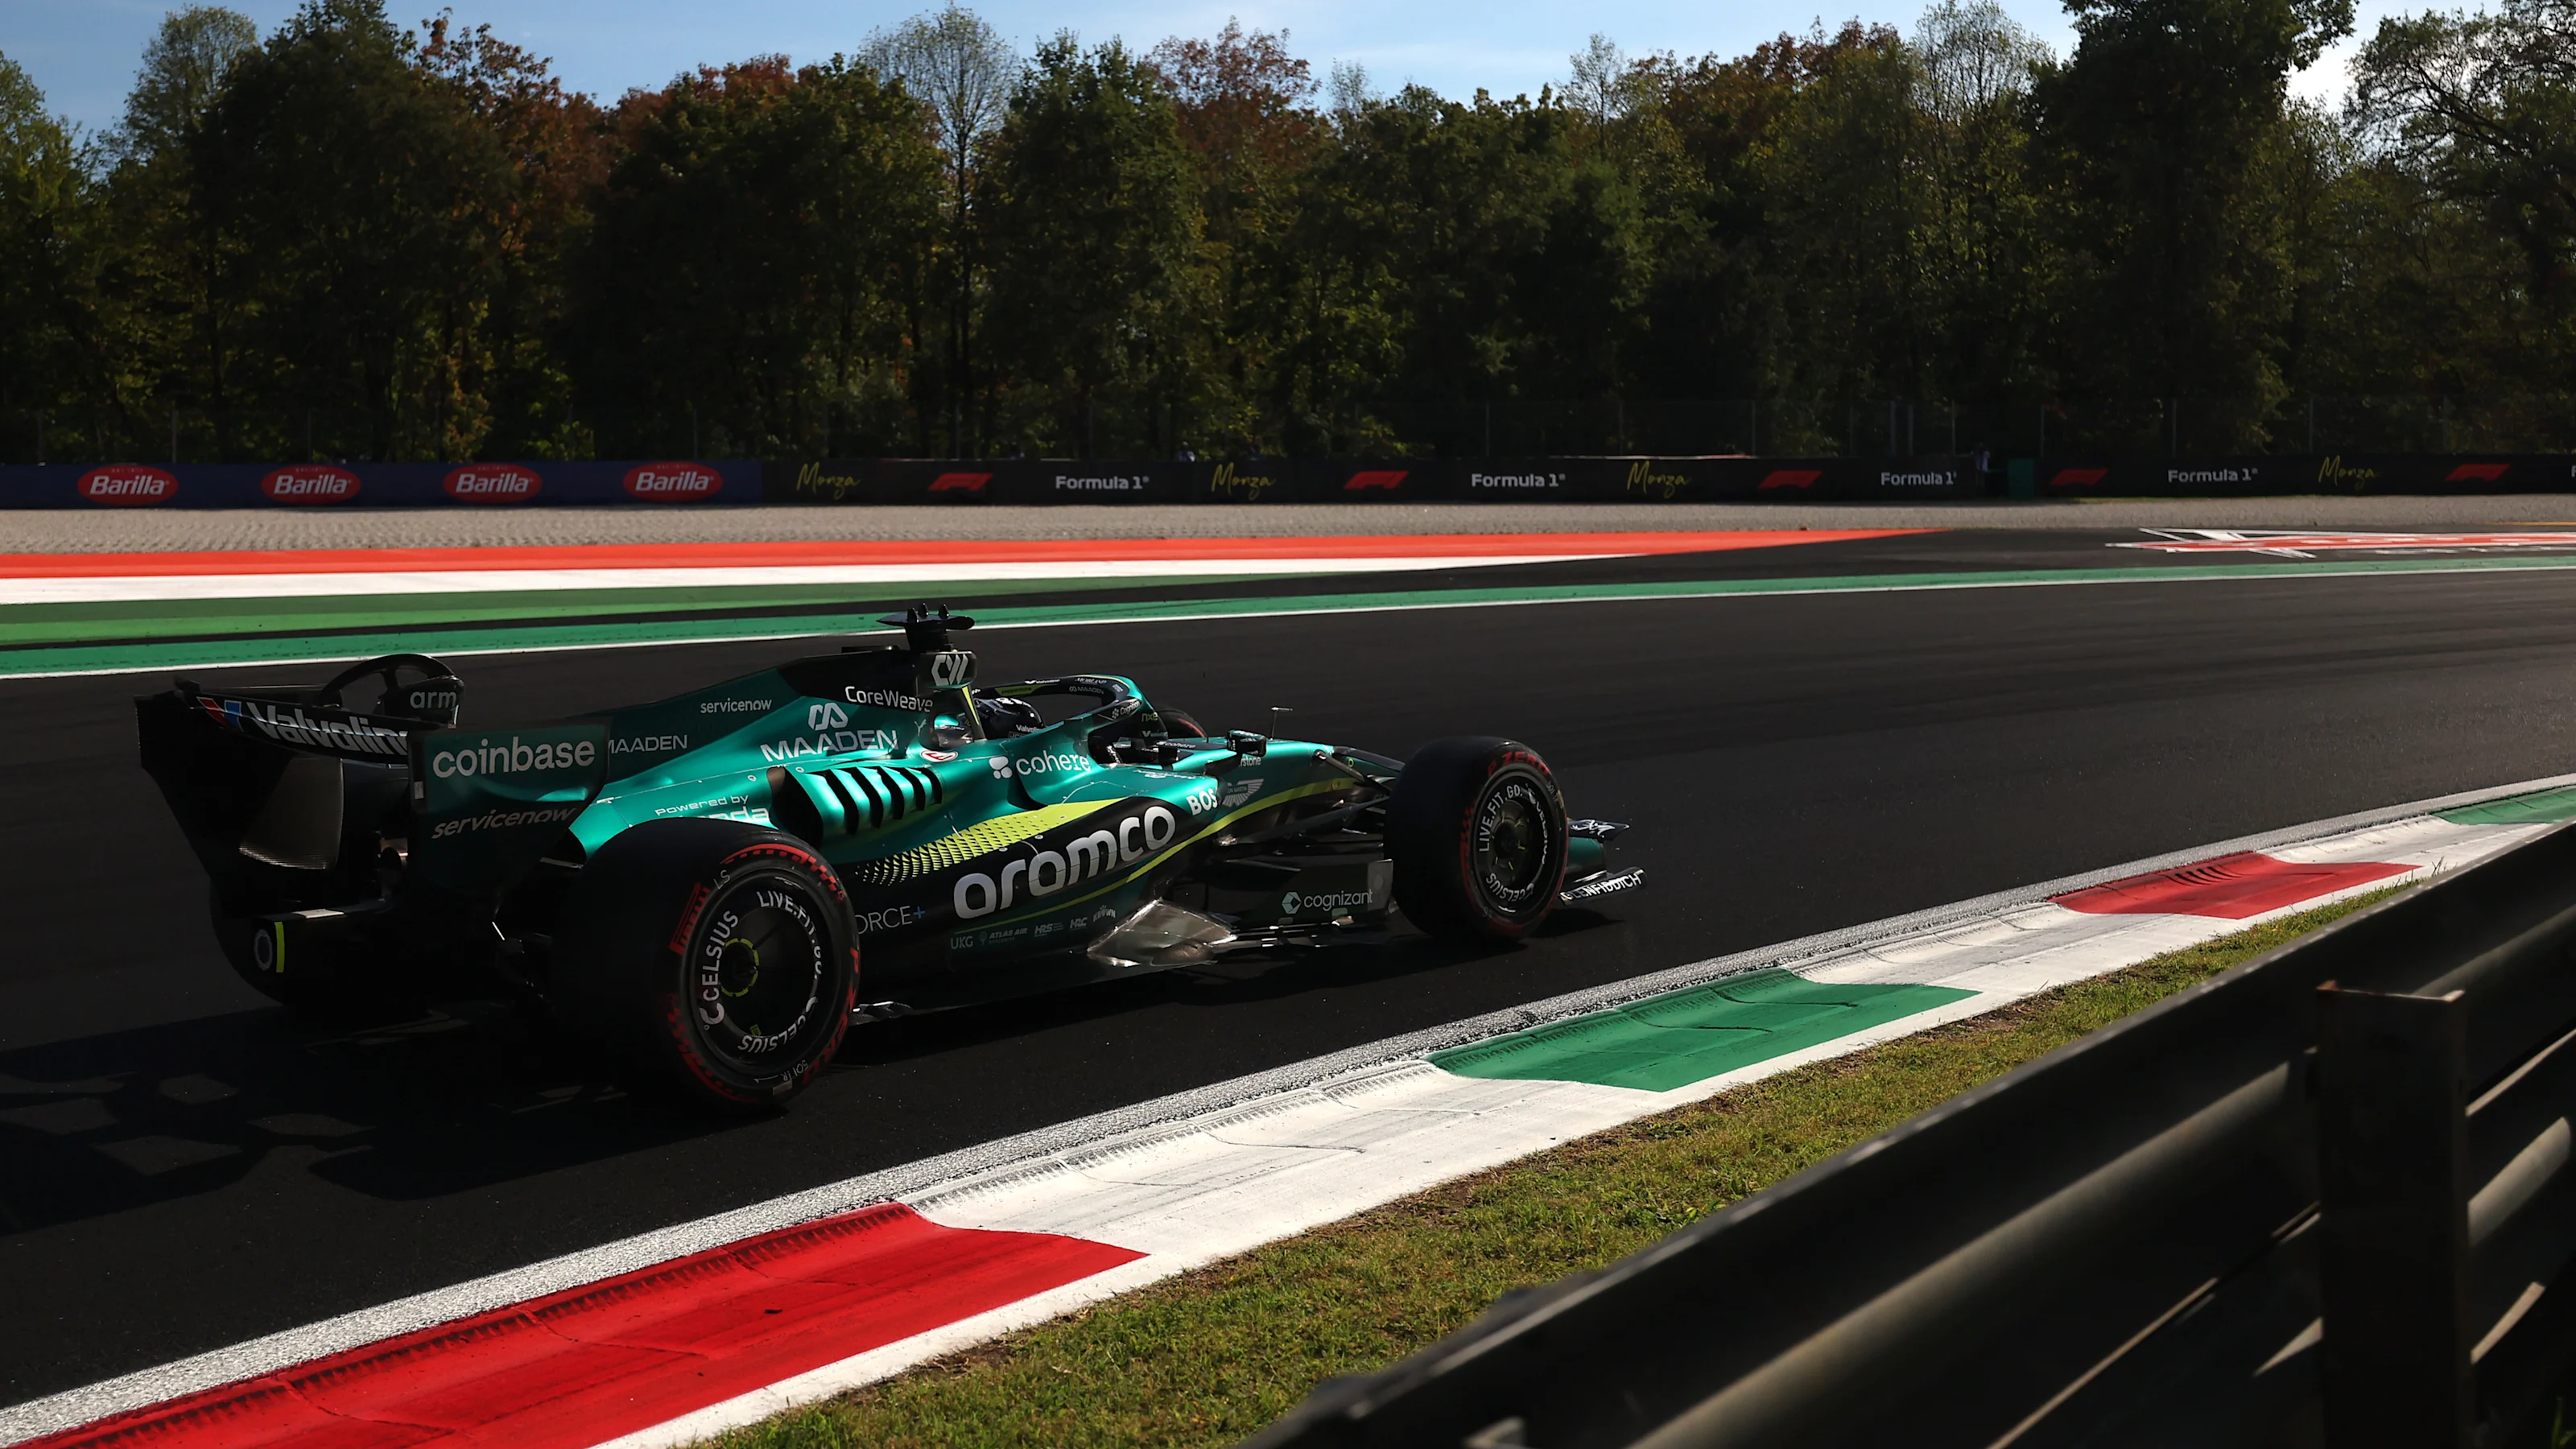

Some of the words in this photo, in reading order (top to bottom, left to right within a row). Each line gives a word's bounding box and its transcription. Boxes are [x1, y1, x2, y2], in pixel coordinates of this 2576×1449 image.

[89, 474, 165, 495] Barilla
[274, 474, 348, 494] Barilla
[456, 473, 529, 493] Barilla
[635, 472, 710, 492] Barilla
[1055, 476, 1129, 490] Formula
[1471, 473, 1545, 488] Formula
[1880, 472, 1942, 485] Formula
[2167, 469, 2239, 483] Formula
[409, 691, 457, 709] arm
[700, 699, 772, 714] servicenow
[844, 686, 933, 713] CoreWeave
[759, 729, 899, 762] MAADEN
[432, 736, 596, 778] coinbase
[1016, 749, 1091, 775] cohere
[654, 795, 729, 817] Powered
[730, 795, 749, 805] by
[1185, 787, 1219, 816] BOS
[431, 807, 576, 840] servicenow
[952, 805, 1176, 920] aramco
[1485, 873, 1525, 902] CELSIUS
[1303, 888, 1373, 912] cognizant
[950, 935, 973, 950] UKG
[701, 910, 740, 1002] CELSIUS
[737, 1013, 807, 1054] CELSIUS
